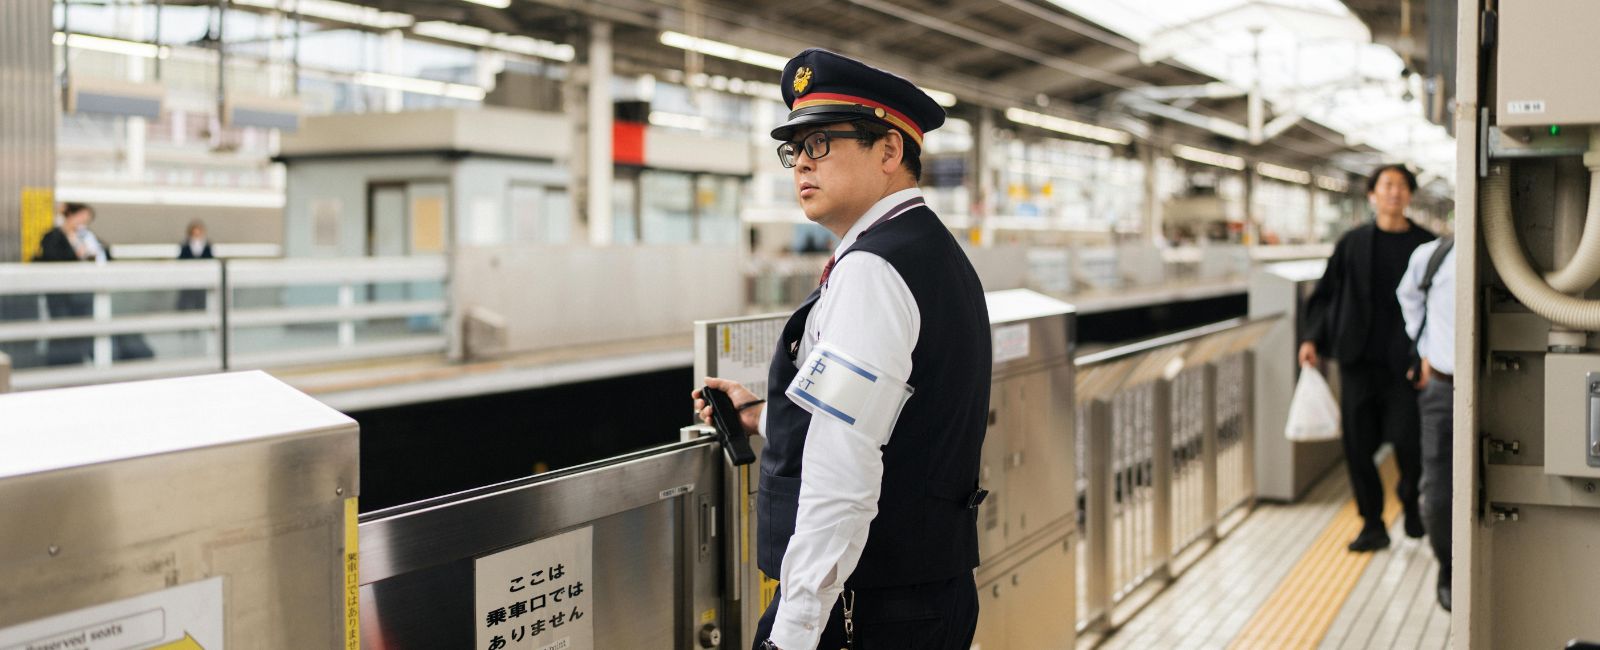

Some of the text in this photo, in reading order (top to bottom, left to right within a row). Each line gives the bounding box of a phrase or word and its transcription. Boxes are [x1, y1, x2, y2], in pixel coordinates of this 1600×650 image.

[810, 358, 826, 376] 中
[509, 563, 565, 593] ここは
[486, 581, 584, 628] 乗車口では
[488, 606, 584, 650] ありません
